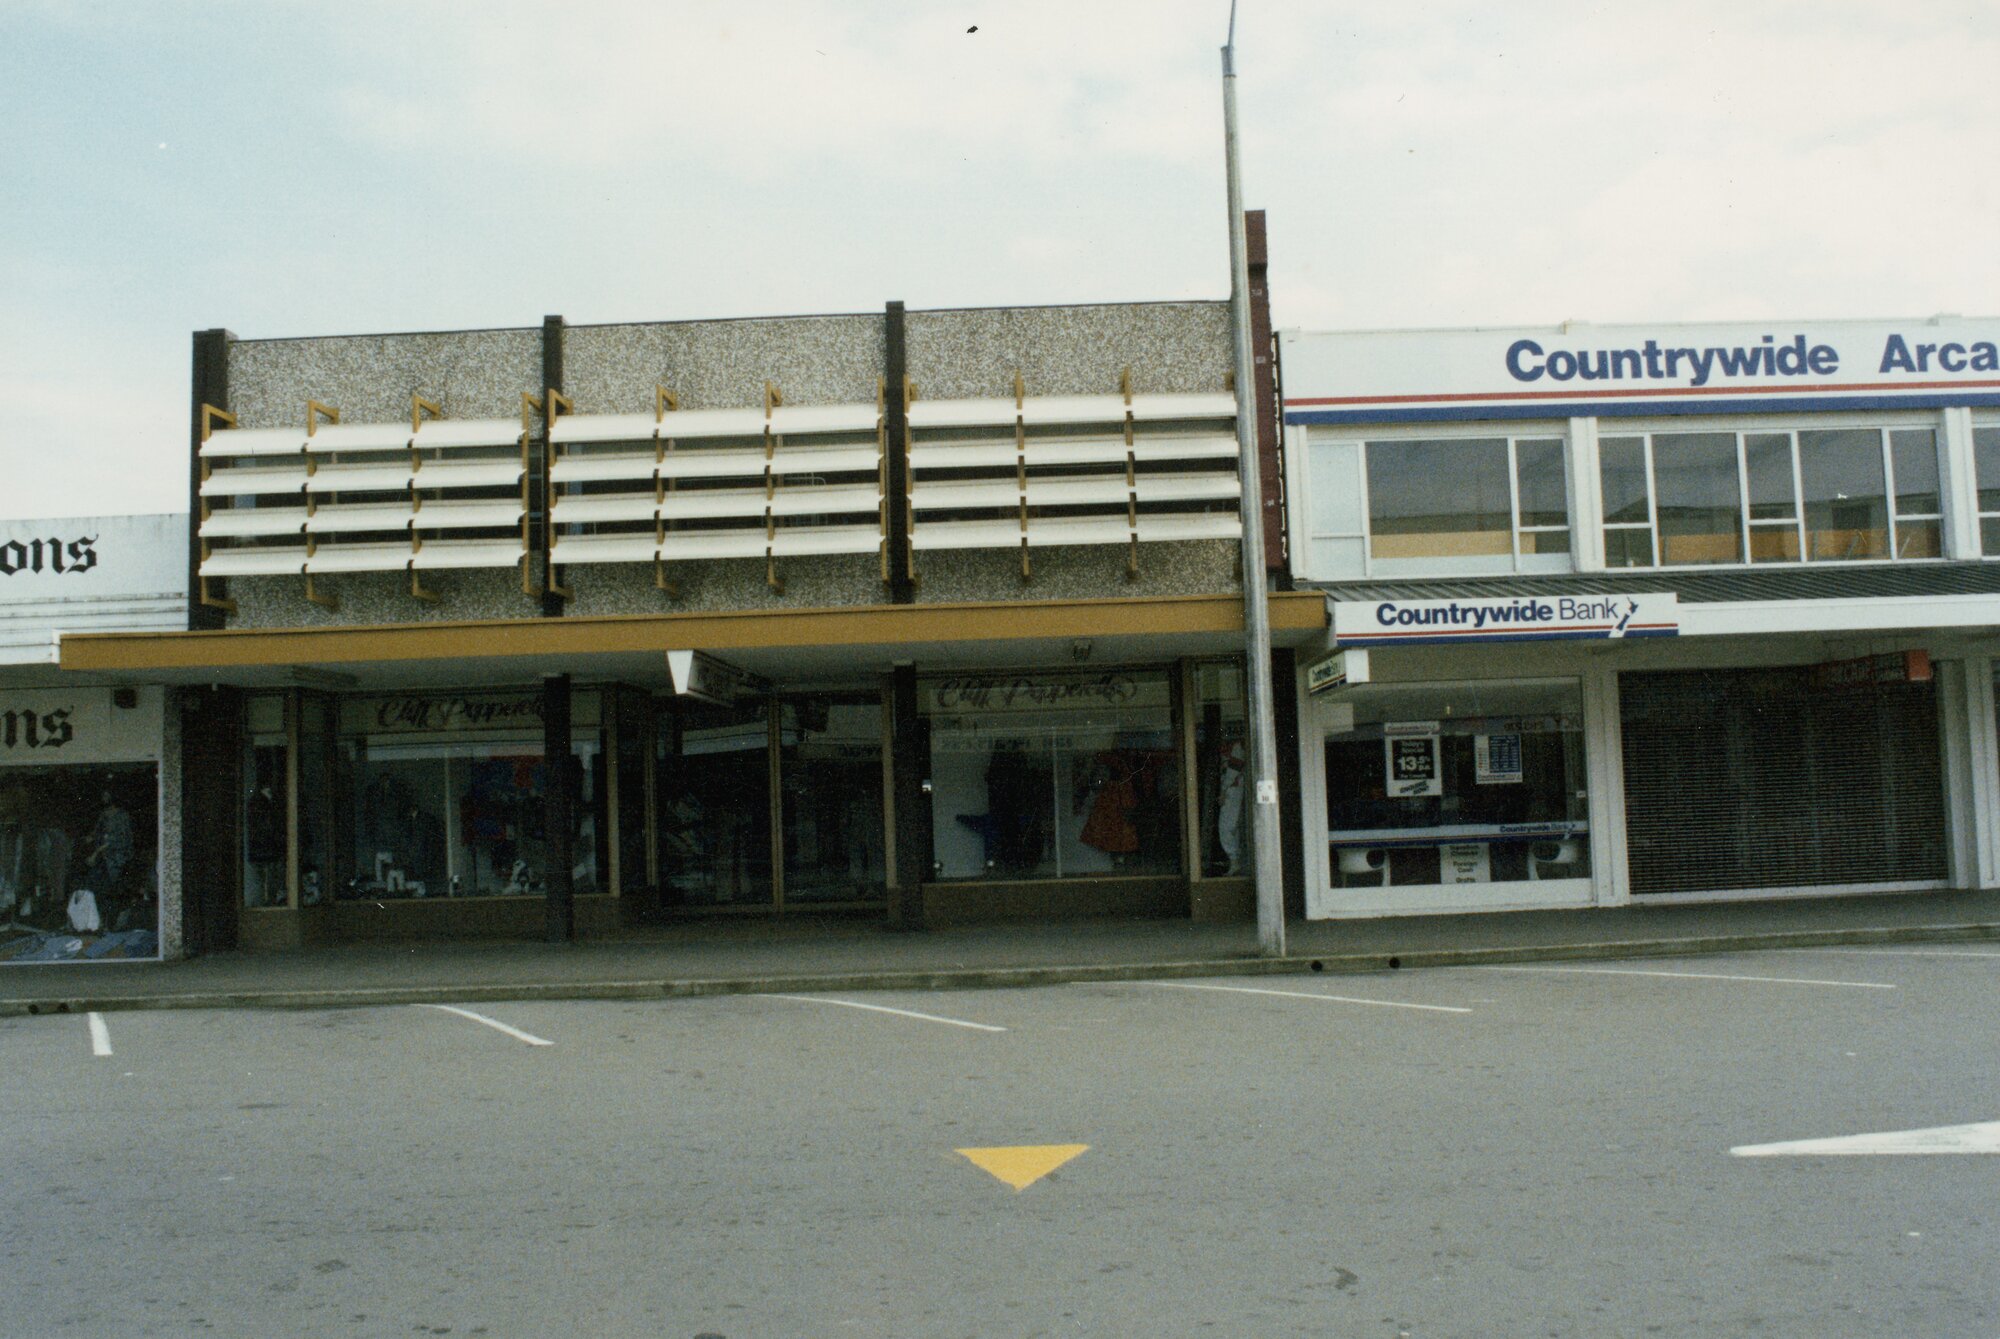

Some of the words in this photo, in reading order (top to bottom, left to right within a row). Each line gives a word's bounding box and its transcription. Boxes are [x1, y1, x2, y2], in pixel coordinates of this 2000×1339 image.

[1505, 335, 1839, 387] Countrywide
[1879, 334, 2000, 374] Arca
[0, 533, 99, 576] ons
[1376, 600, 1554, 628] Countrywide
[1559, 598, 1618, 621] Bank
[0, 705, 74, 748] ns
